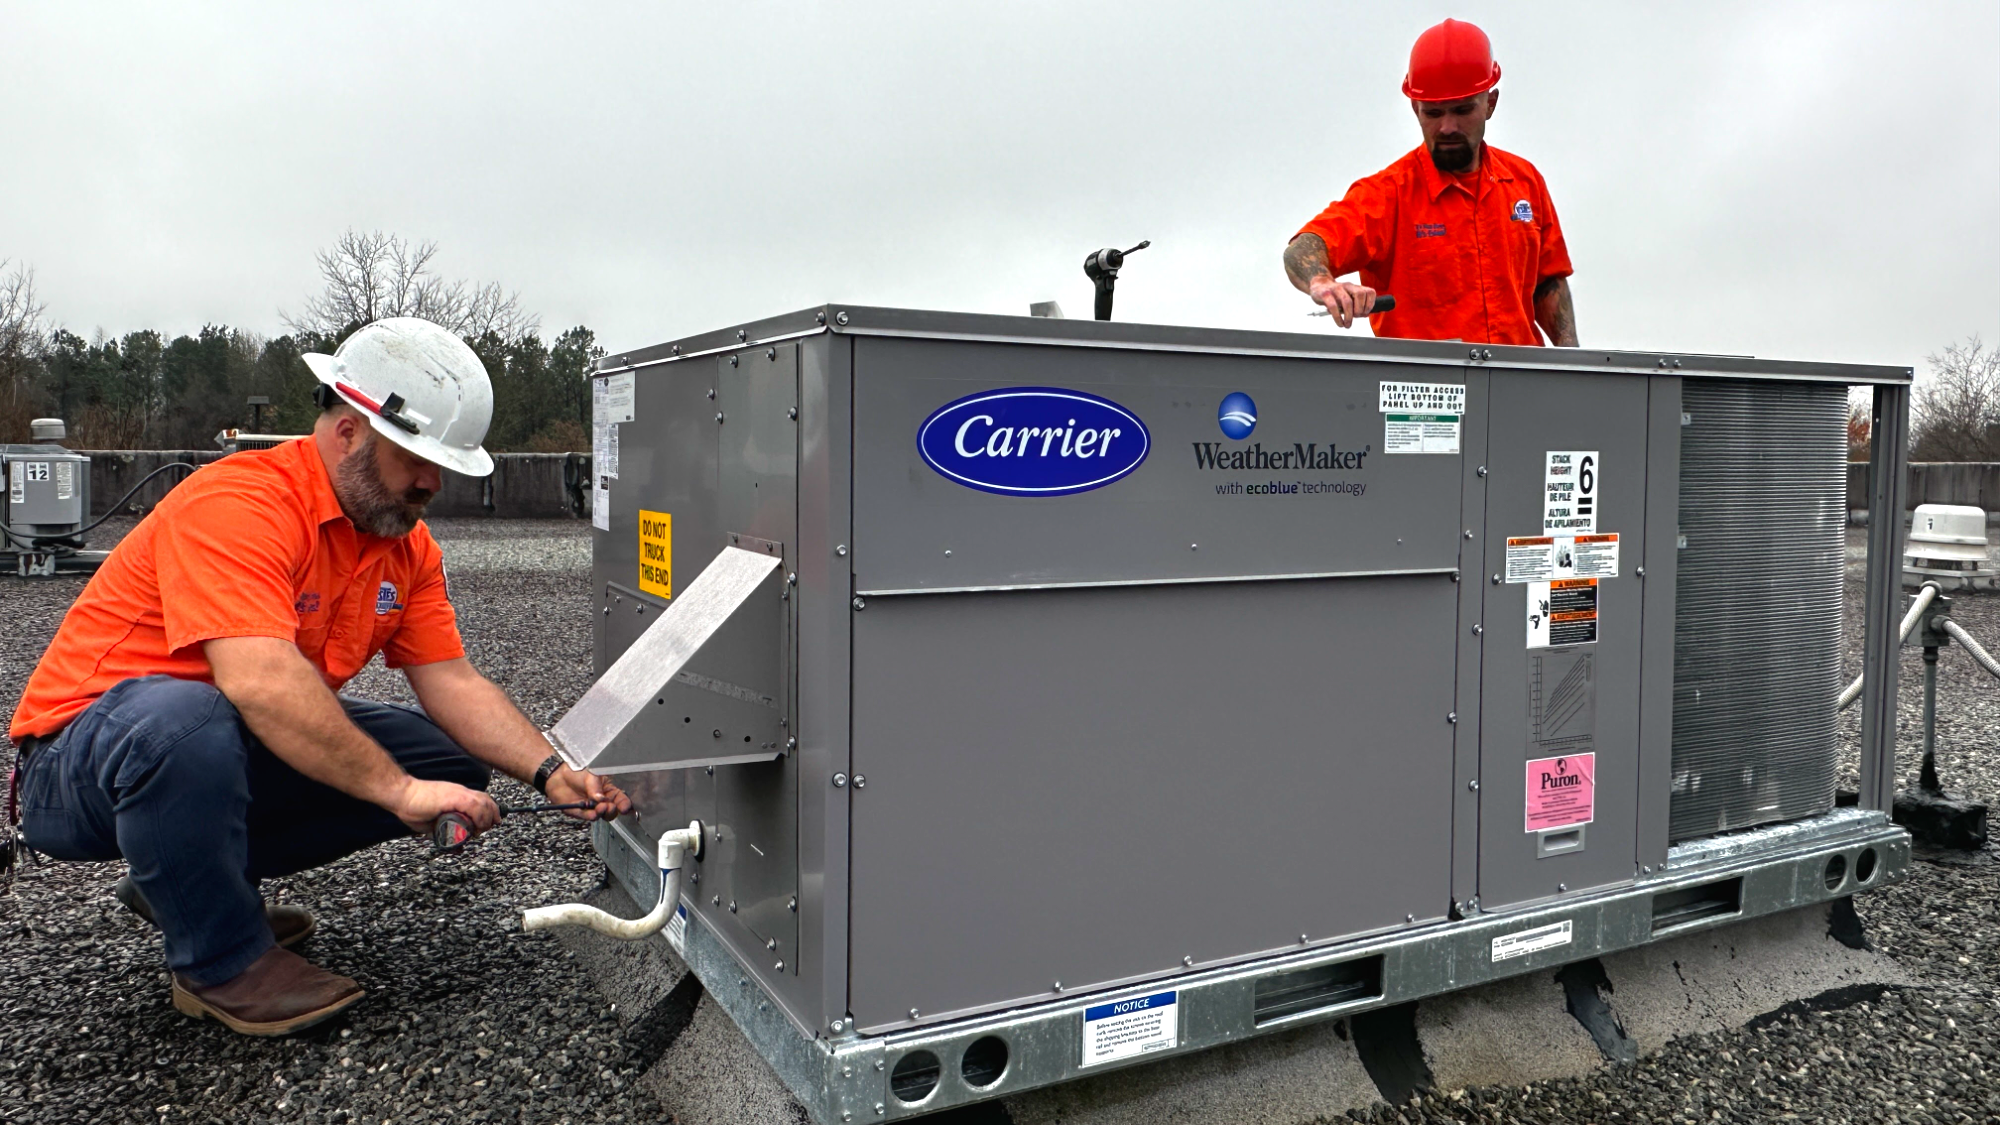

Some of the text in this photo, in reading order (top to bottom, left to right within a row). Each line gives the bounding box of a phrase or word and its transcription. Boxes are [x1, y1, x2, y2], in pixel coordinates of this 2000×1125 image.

[1402, 385, 1430, 393] FILTER
[1411, 393, 1444, 401] BOTTOM
[1382, 401, 1409, 409] PANEL
[954, 414, 1121, 459] Carrier
[1551, 454, 1571, 464] STACK
[29, 470, 47, 480] 12
[1579, 455, 1594, 495] 6
[1215, 482, 1243, 495] with
[1302, 481, 1367, 497] technology
[642, 519, 667, 540] DO NOT
[644, 541, 666, 563] TRUCK
[641, 562, 669, 586] THIS END
[1541, 772, 1578, 790] Puron
[1114, 998, 1150, 1014] NOTICE
